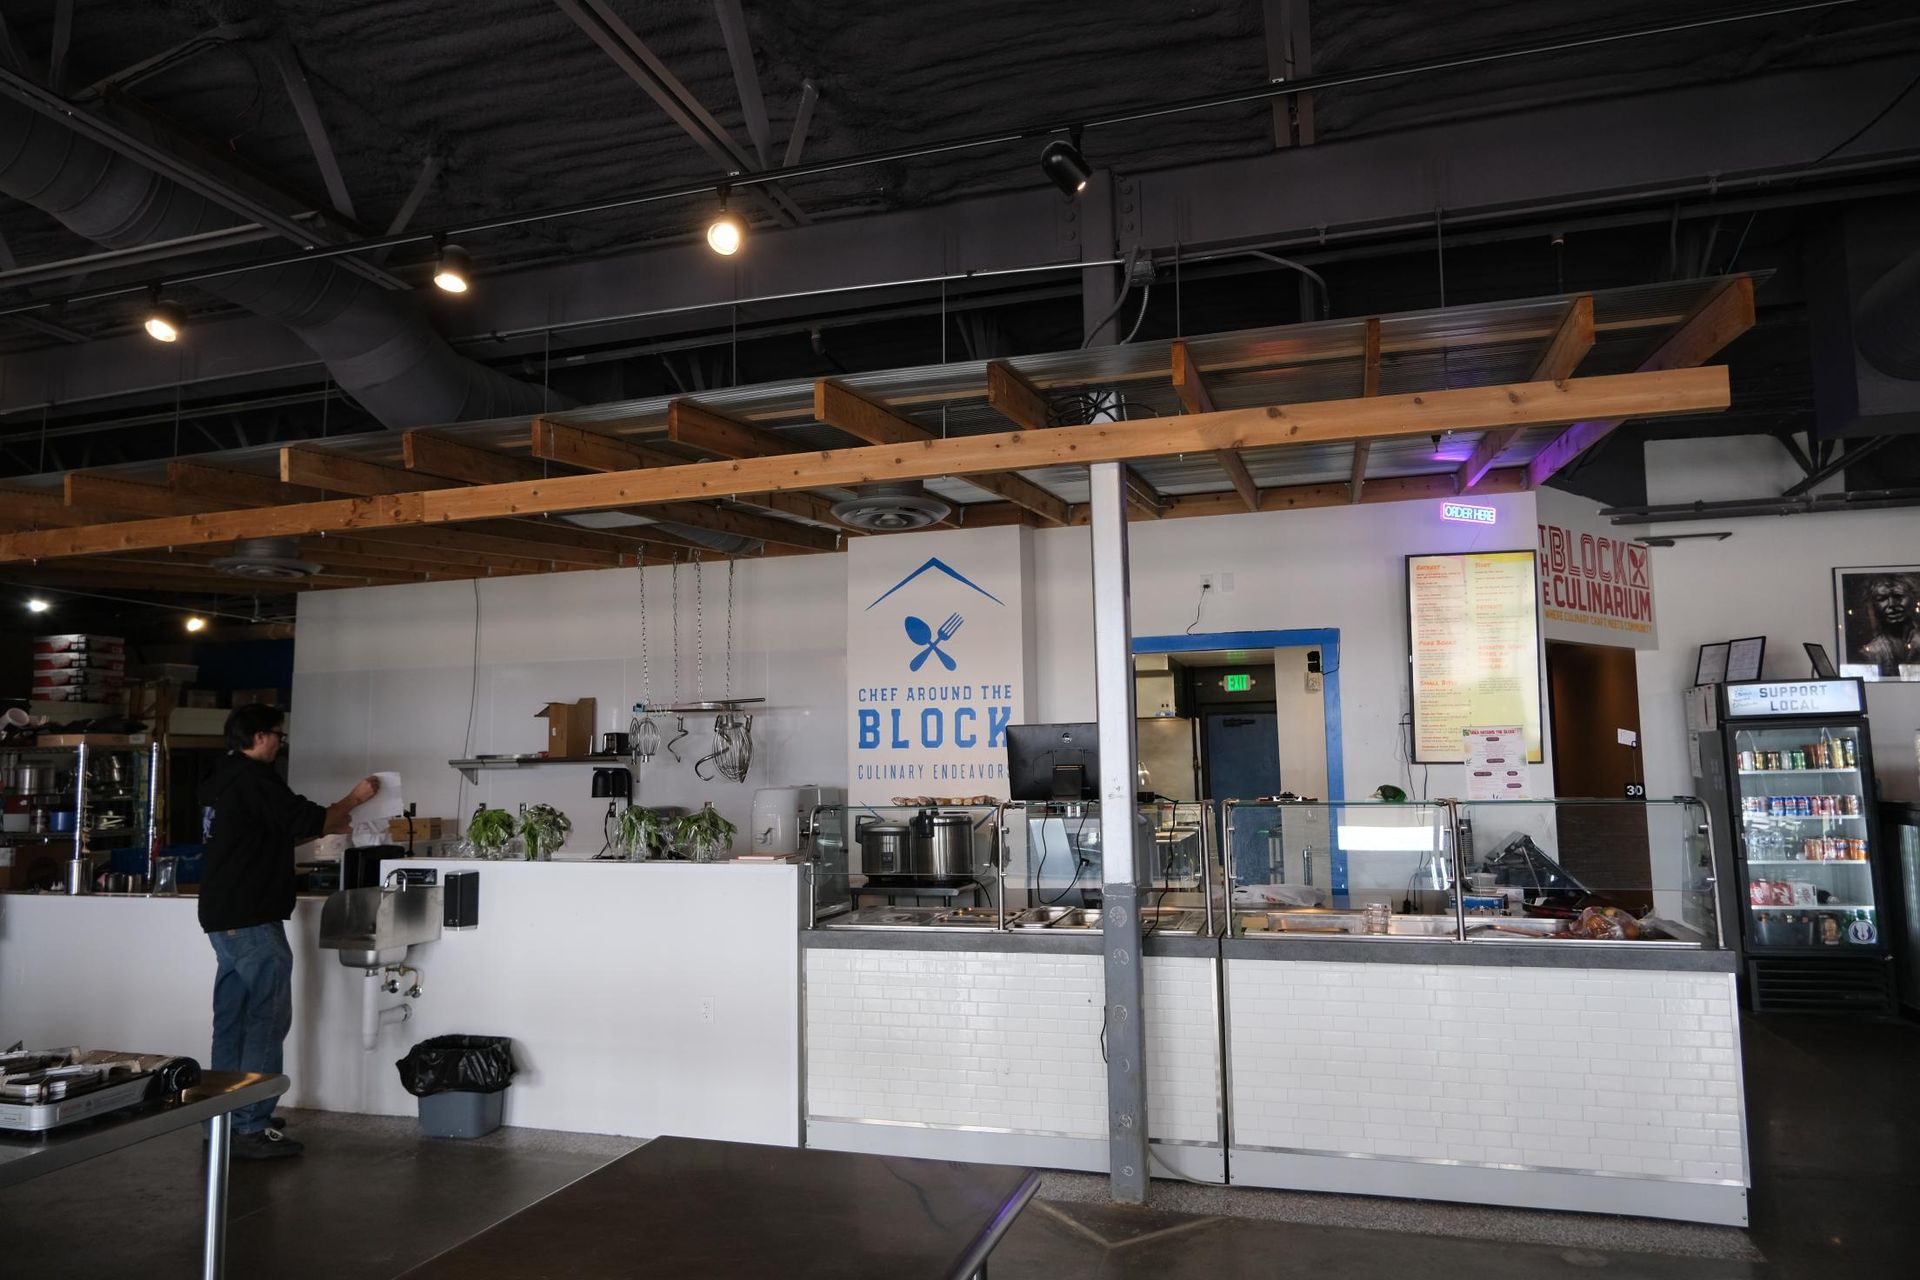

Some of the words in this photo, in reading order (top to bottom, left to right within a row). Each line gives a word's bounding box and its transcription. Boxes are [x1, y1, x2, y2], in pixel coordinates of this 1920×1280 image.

[1445, 506, 1473, 520] ORDER
[1474, 508, 1494, 521] HERE
[1549, 526, 1627, 586] BLOCK
[1553, 574, 1652, 622] CULINARIUM
[1564, 612, 1590, 625] CULINARY
[1607, 617, 1624, 630] MEETS
[1625, 620, 1652, 634] COMMUNITY
[1228, 675, 1247, 691] EXIT
[858, 687, 898, 702] CHEF
[907, 685, 972, 701] AROUND
[981, 684, 1012, 700] THE
[1759, 685, 1827, 698] SUPPORT
[1770, 699, 1820, 712] LOCAL
[858, 706, 1012, 750] BLOCK
[858, 764, 924, 780] CULINARY
[1626, 785, 1643, 796] 30
